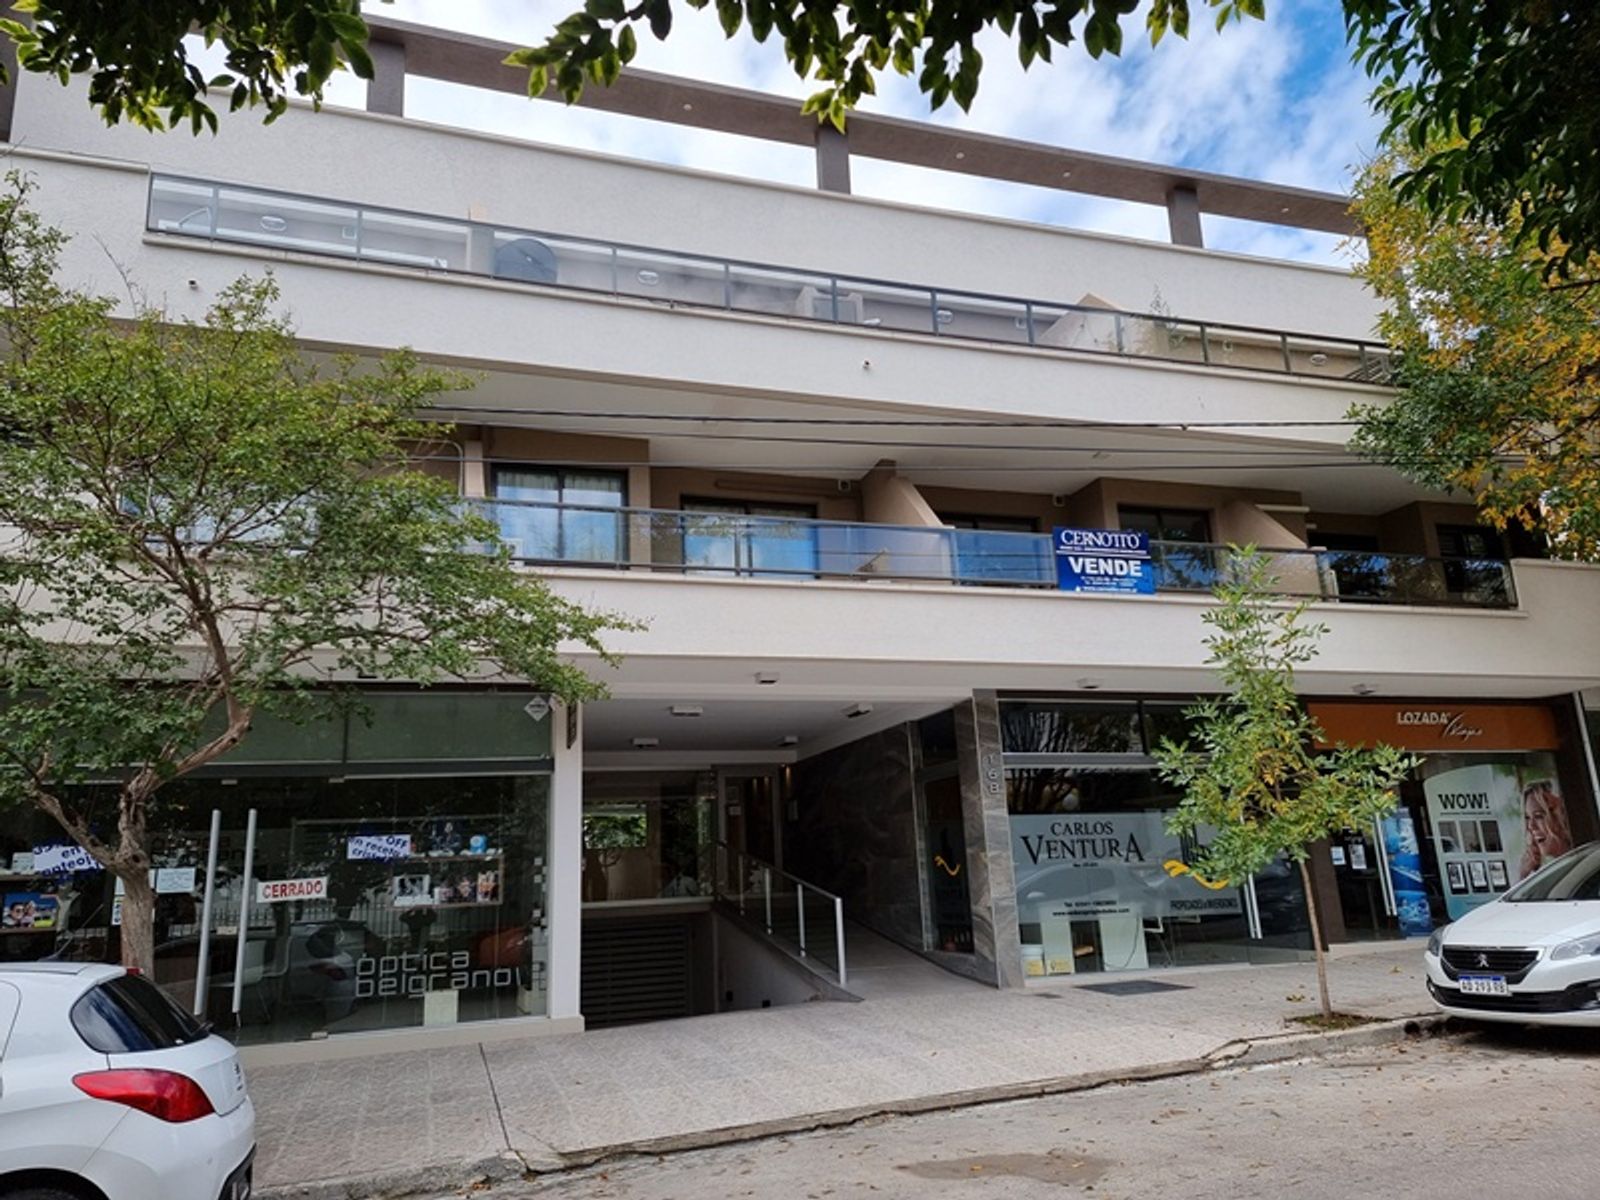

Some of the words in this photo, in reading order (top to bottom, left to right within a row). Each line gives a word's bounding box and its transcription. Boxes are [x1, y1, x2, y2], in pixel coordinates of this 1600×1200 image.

[1061, 530, 1141, 549] CERNOTTO
[1068, 556, 1142, 577] VENDE
[1397, 711, 1449, 725] LOZADA
[1438, 791, 1490, 810] WOW!
[1050, 821, 1114, 836] CARLOS
[1021, 832, 1145, 865] VENTURA
[262, 880, 323, 899] CERRADO
[355, 968, 512, 998] belgrano
